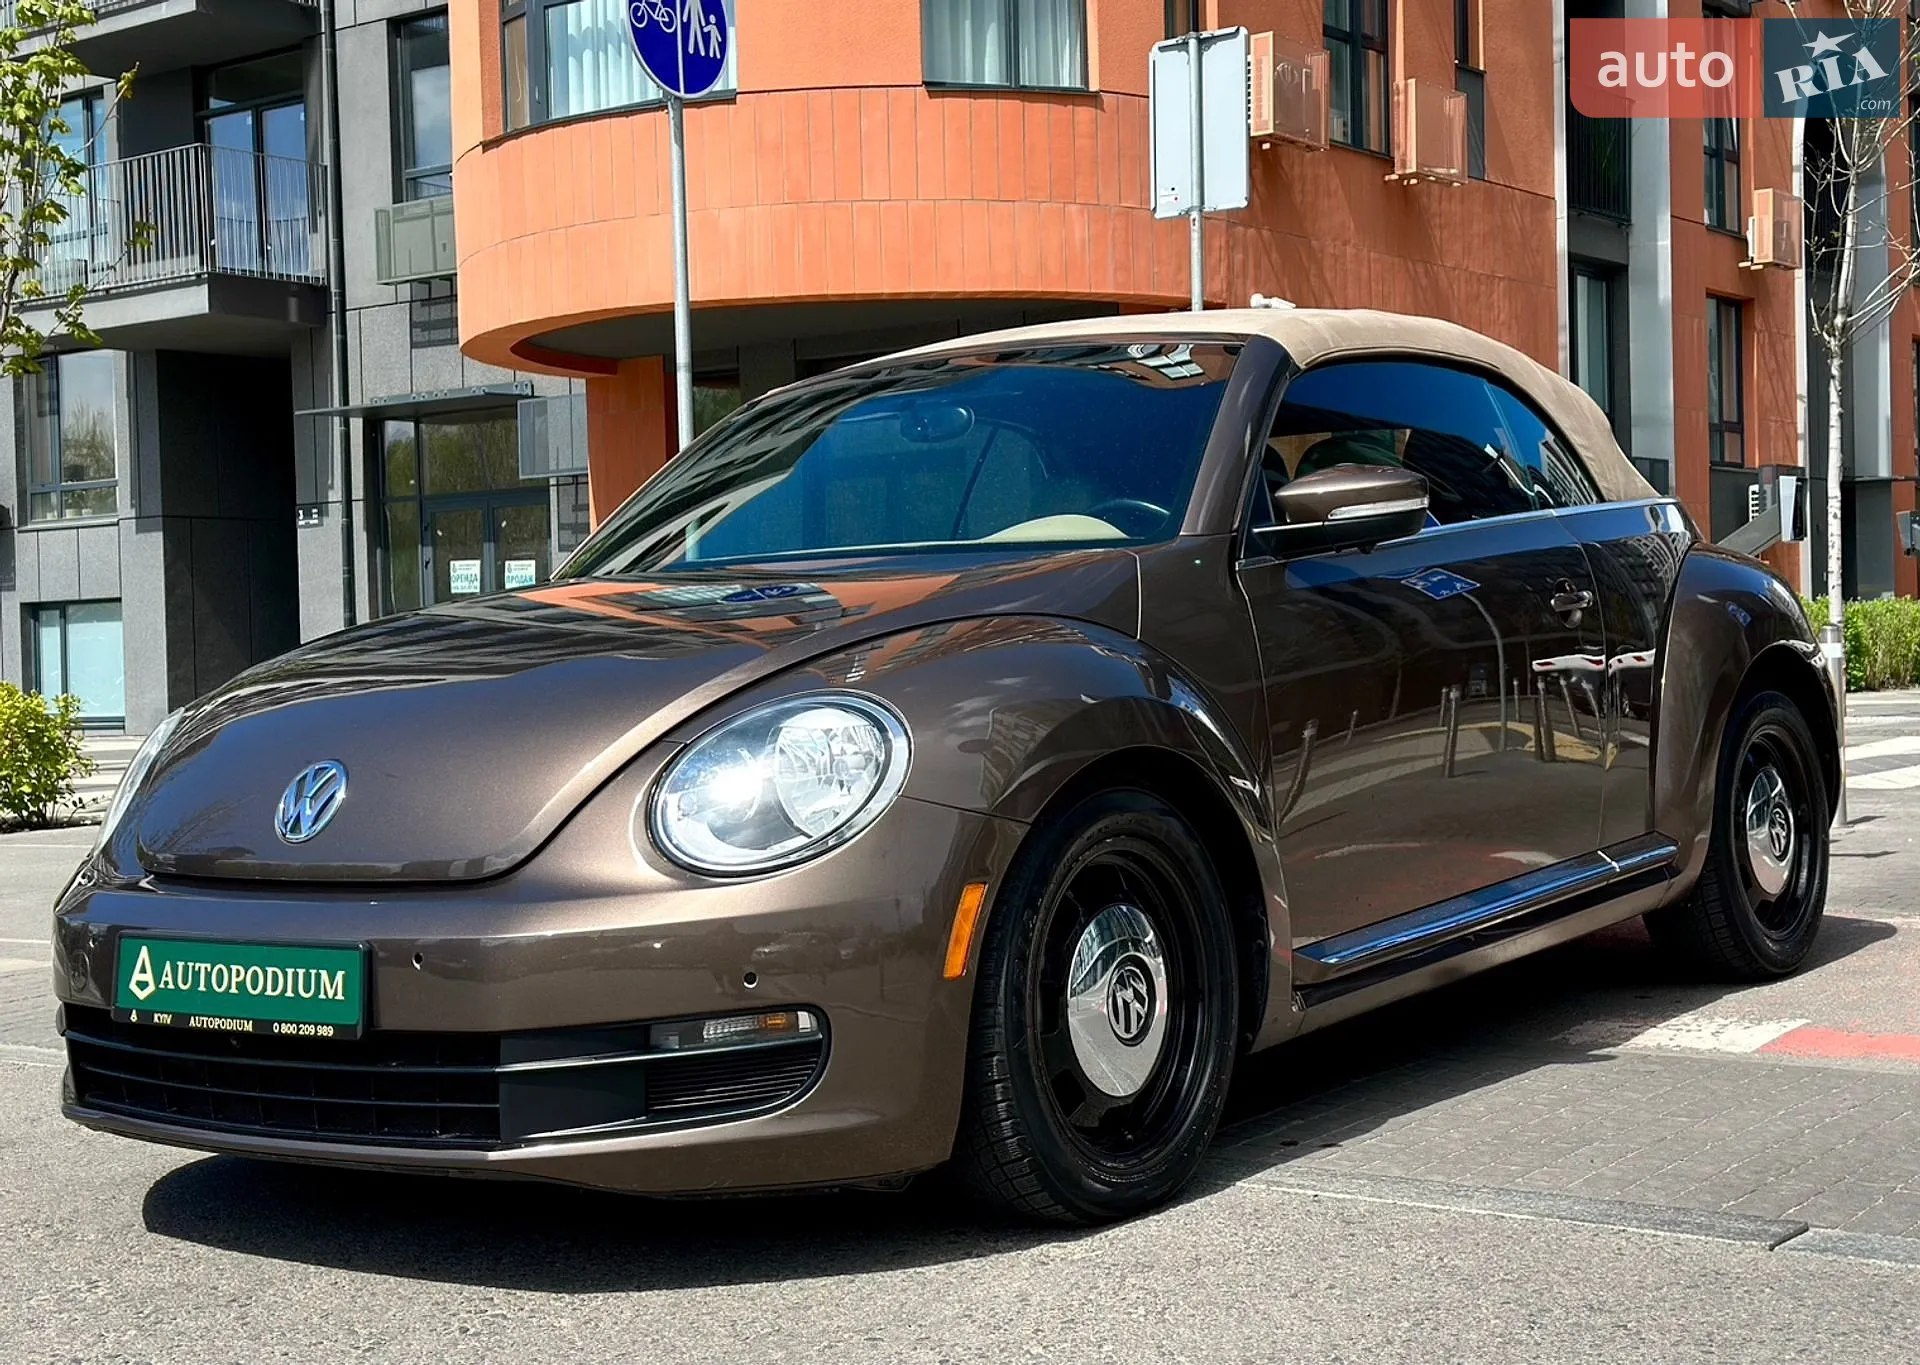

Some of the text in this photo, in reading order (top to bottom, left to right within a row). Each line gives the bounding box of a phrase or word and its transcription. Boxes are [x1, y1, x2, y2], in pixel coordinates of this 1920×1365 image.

[158, 960, 346, 1000] AUTOPODIUM
[153, 1013, 172, 1024] KYIV
[189, 1016, 253, 1031] AUTOPODIUM
[280, 1024, 297, 1034] 800
[298, 1025, 315, 1035] 209
[316, 1026, 334, 1036] 989
